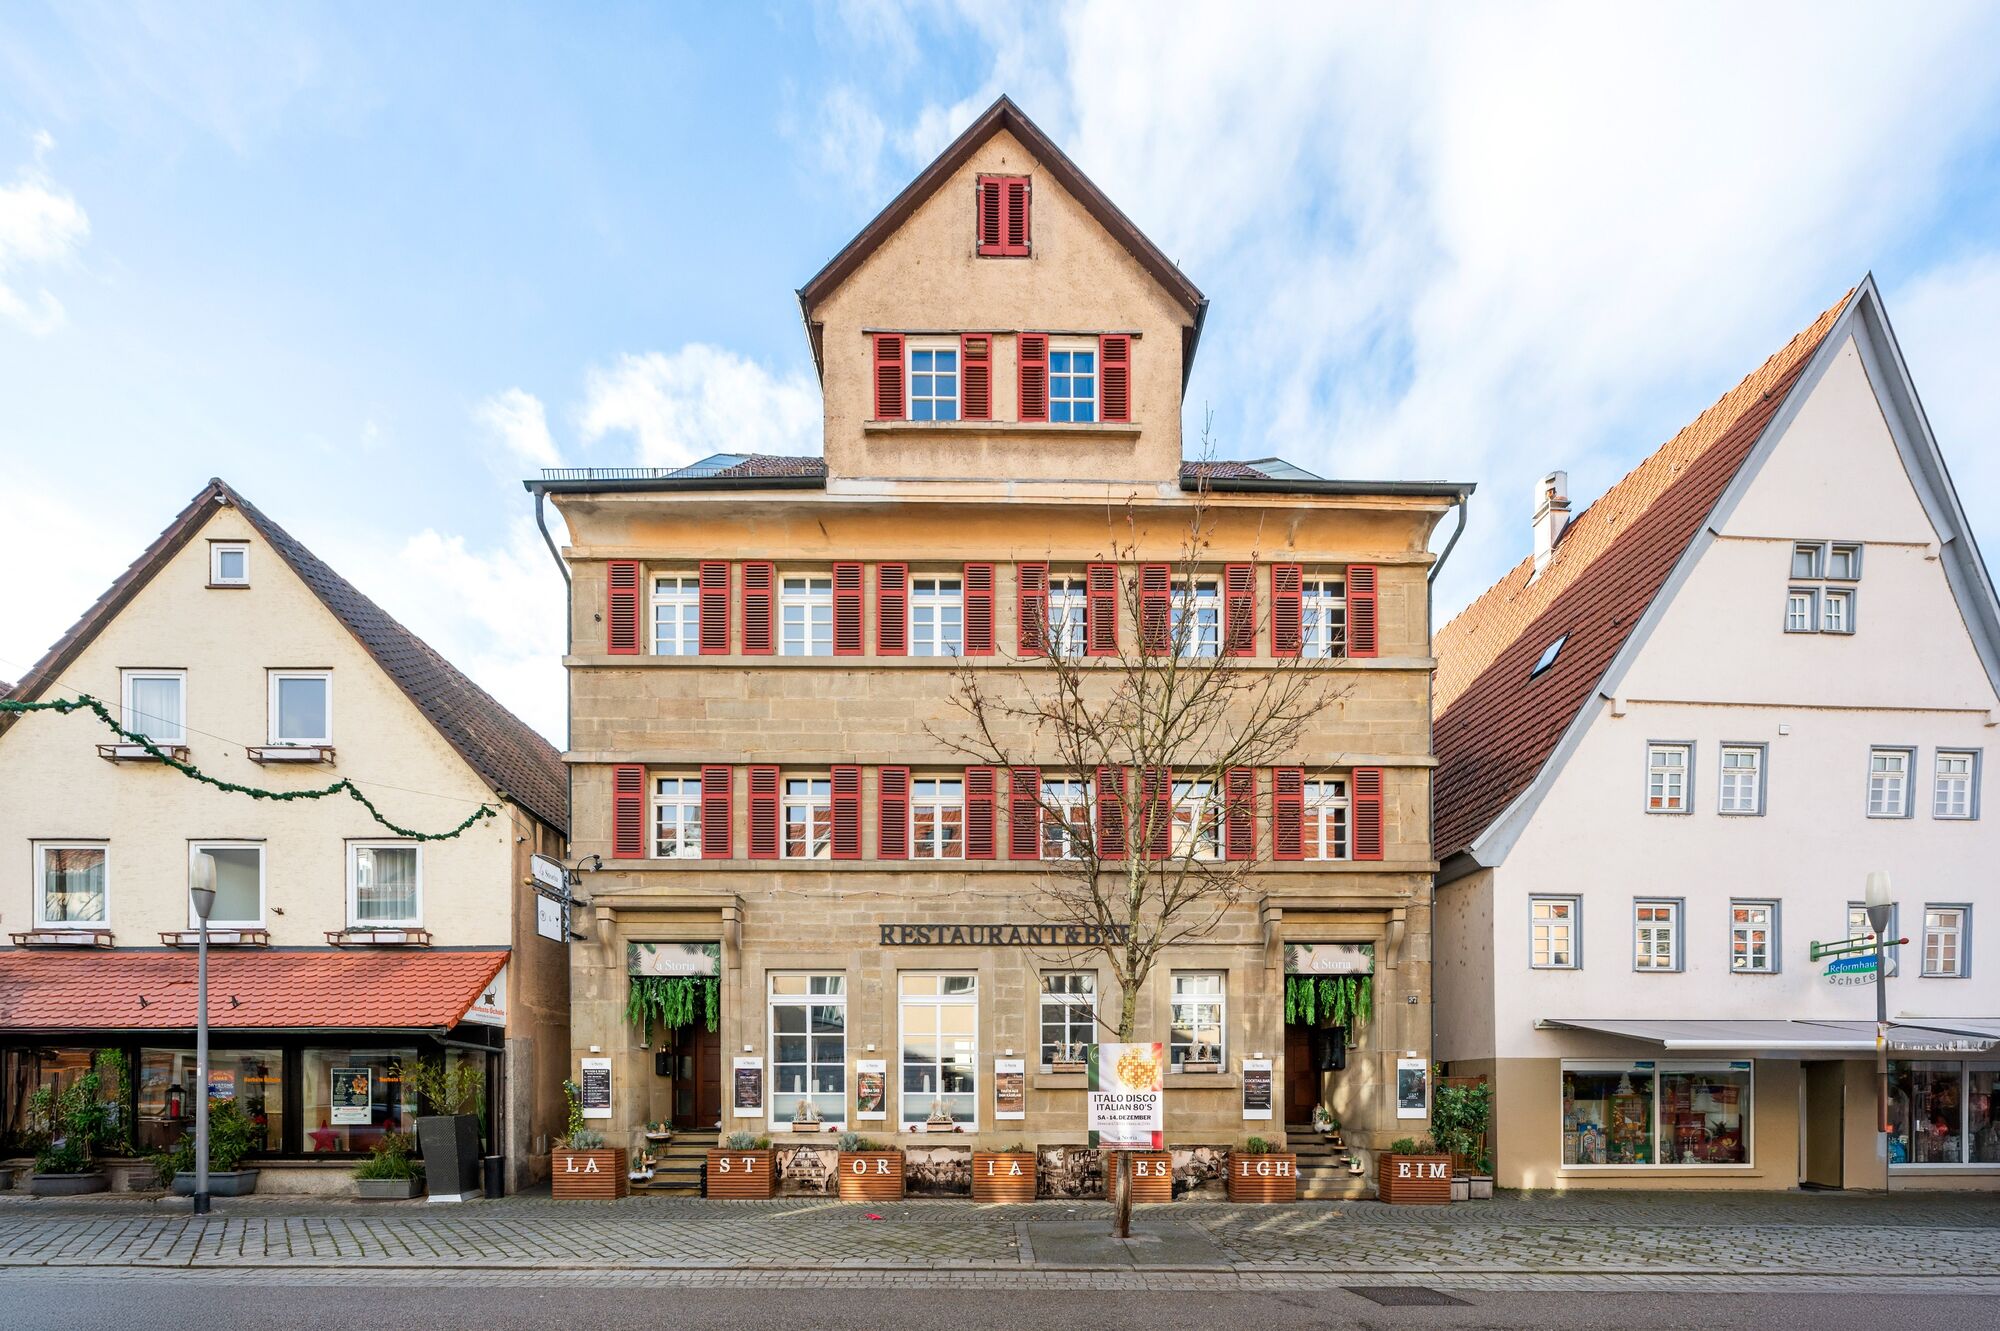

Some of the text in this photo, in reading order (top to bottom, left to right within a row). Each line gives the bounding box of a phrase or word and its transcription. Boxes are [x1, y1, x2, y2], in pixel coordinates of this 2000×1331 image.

[665, 960, 695, 971] Storia
[1321, 959, 1352, 970] Storia
[1829, 973, 1877, 986] Schere
[1094, 1094, 1157, 1103] ITALO DISCO
[1096, 1103, 1153, 1111] ITALIAN 80'S
[566, 1157, 600, 1173] LA
[719, 1157, 756, 1173] ST
[852, 1159, 891, 1175] OR
[987, 1160, 1023, 1176] IA
[1135, 1160, 1167, 1177] ES
[1241, 1161, 1290, 1177] IGH
[1398, 1162, 1447, 1178] EIM
